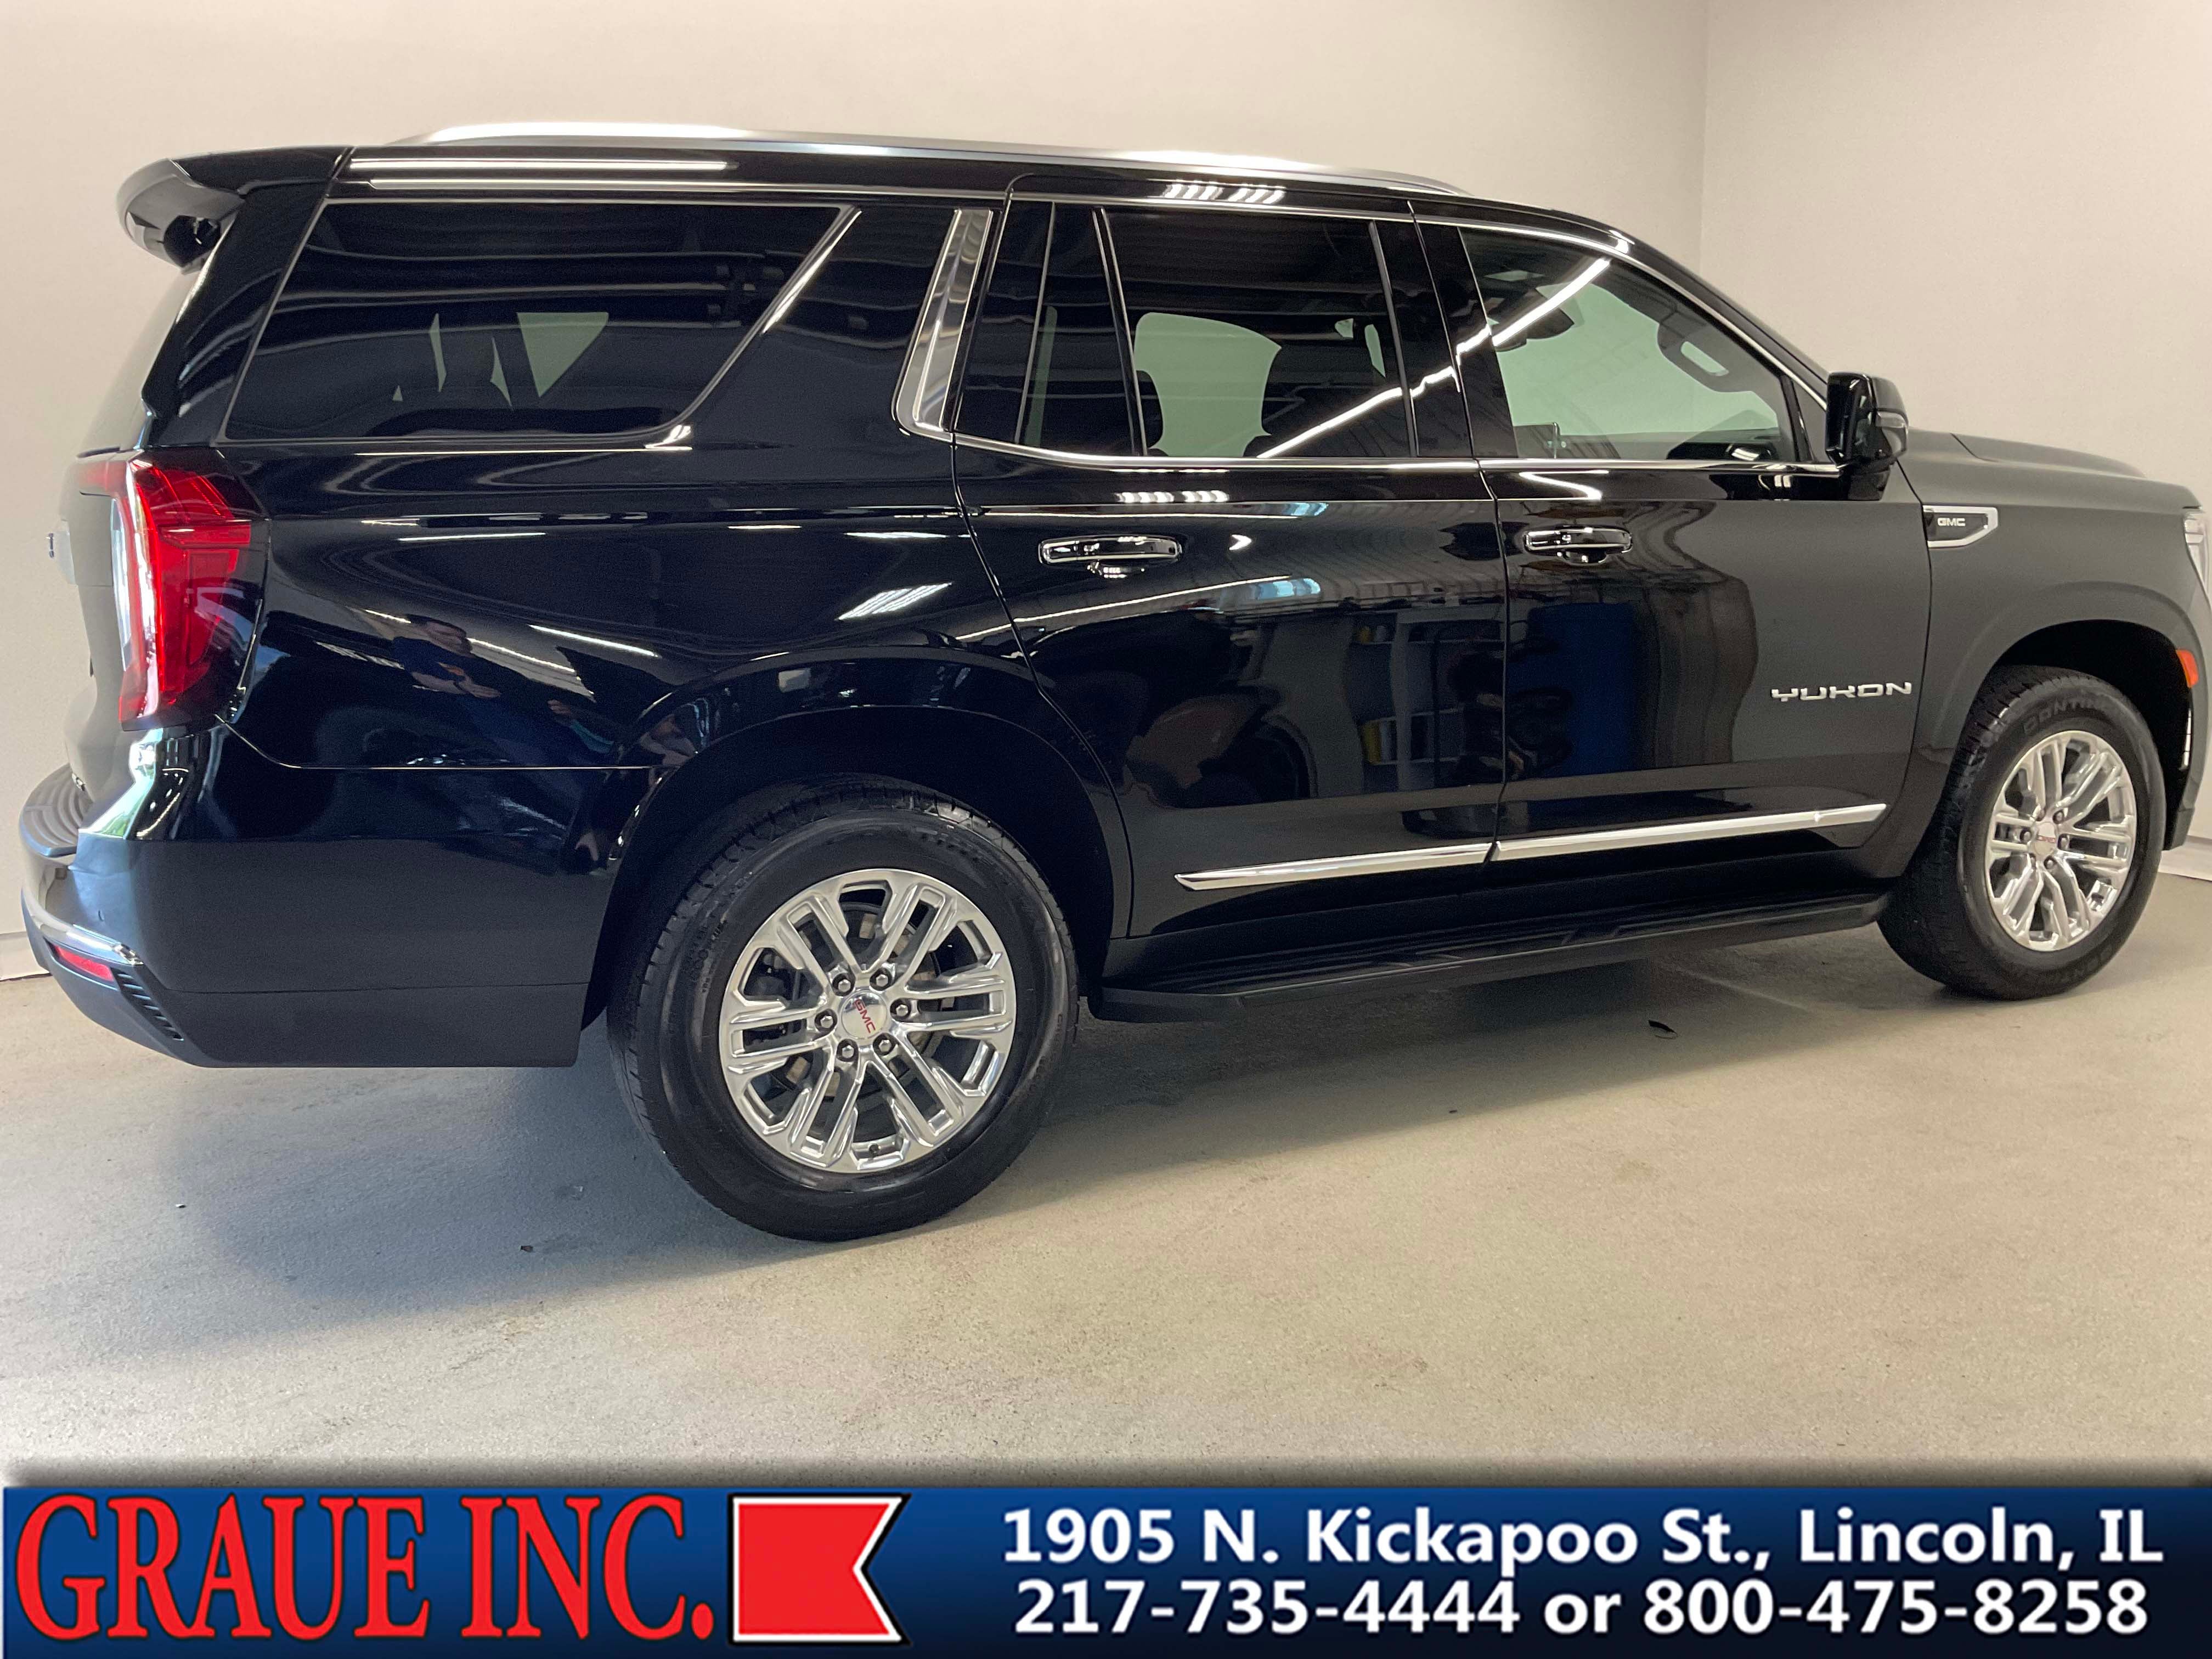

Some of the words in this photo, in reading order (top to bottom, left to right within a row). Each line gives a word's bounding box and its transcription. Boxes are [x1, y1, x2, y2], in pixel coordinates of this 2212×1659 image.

[1937, 517, 1966, 527] GMC
[1771, 681, 1912, 702] YUKON
[854, 998, 876, 1034] GMC
